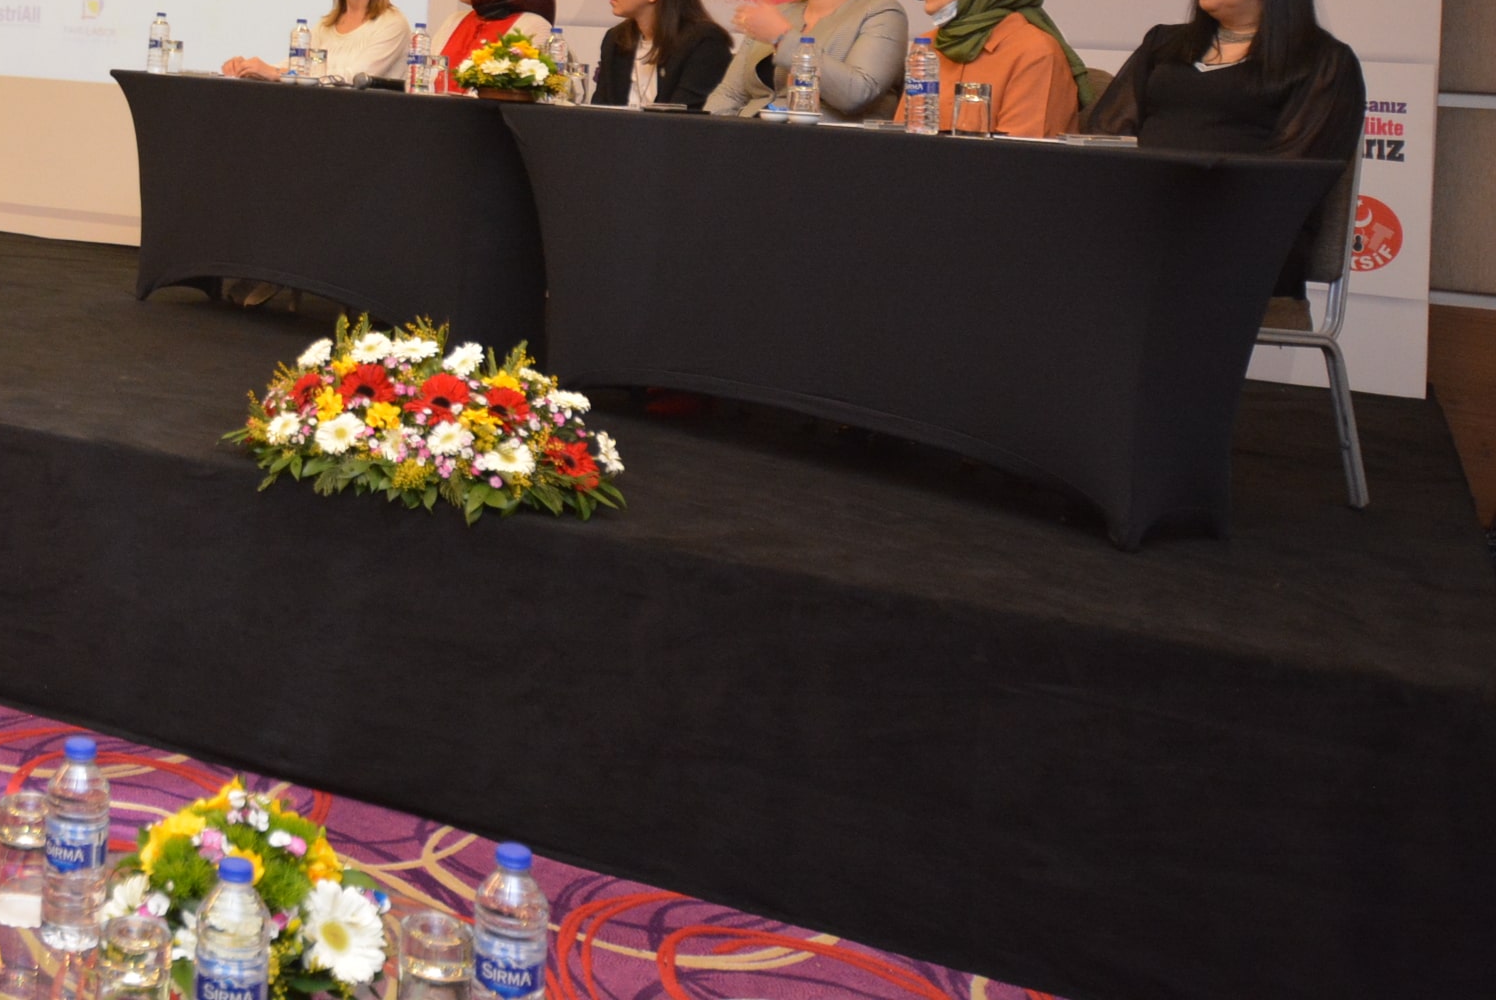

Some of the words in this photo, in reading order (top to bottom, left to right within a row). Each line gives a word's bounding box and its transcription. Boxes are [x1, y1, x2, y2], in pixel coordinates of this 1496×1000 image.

[1365, 116, 1404, 136] likte
[1361, 138, 1405, 162] rız
[1351, 244, 1393, 270] KSİF
[482, 961, 532, 987] SIRMA
